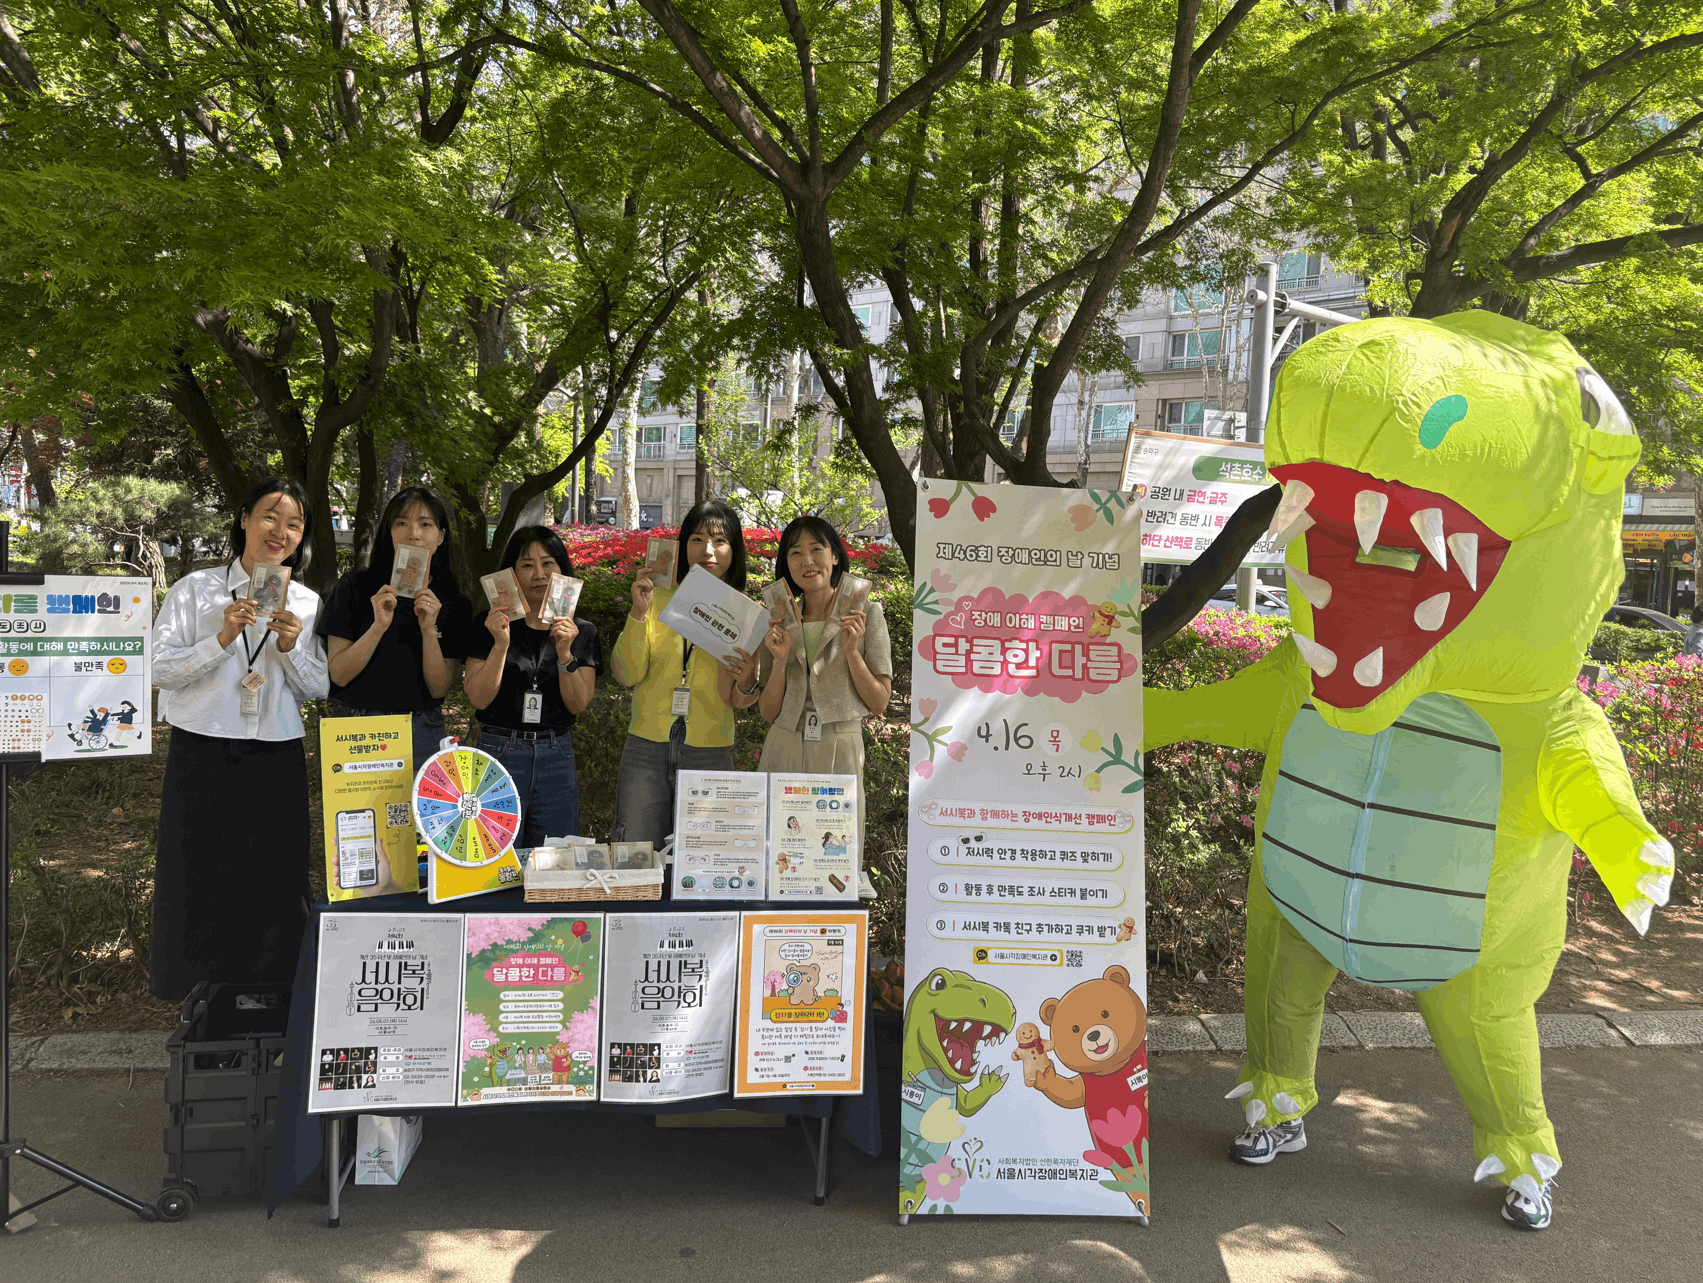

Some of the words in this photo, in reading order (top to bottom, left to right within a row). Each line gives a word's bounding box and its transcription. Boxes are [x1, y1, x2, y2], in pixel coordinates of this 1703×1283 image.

[1219, 462, 1263, 482] 석촌호수
[1150, 485, 1172, 501] 공원
[1174, 488, 1184, 502] 내
[1186, 489, 1228, 506] 금연·금주
[1145, 510, 1178, 526] 반려견
[1180, 512, 1200, 528] 동반
[1202, 514, 1212, 528] 시
[1141, 533, 1162, 548] 하단
[1164, 534, 1193, 550] 산책로
[936, 542, 992, 562] 제46회
[997, 546, 1062, 567] 장애인의
[1066, 551, 1084, 568] 날
[1088, 552, 1120, 570] 기념
[46, 592, 120, 614] 캠페인
[693, 606, 712, 622] 장애인
[710, 619, 724, 632] 관련
[723, 628, 738, 640] 문제
[971, 611, 1002, 628] 장애
[1006, 613, 1035, 630] 이해
[1040, 615, 1084, 632] 캠페인
[38, 642, 64, 652] 대해
[67, 641, 142, 653] 만족하시나요?
[74, 661, 104, 672] 불만족
[933, 635, 1042, 678] 달콤한
[1051, 640, 1122, 683] 다름
[336, 734, 366, 742] 서시복과
[368, 732, 399, 742] 카친하고
[976, 718, 1034, 751] 4.16
[1048, 730, 1062, 752] 목
[348, 744, 380, 754] 선물받자
[1022, 760, 1052, 782] 오후
[1058, 764, 1082, 778] 2시
[939, 807, 976, 820] 서시복과
[979, 808, 1018, 822] 함께하는
[1022, 810, 1082, 825] 장애인식개선
[1085, 813, 1117, 827] 캠페인
[966, 846, 994, 860] 저시력
[996, 848, 1017, 862] 안경
[1020, 848, 1056, 862] 착용하고
[1059, 850, 1078, 862] 퀴즈
[1080, 852, 1112, 864] 맞히기!
[964, 883, 982, 896] 활동
[986, 884, 994, 897] 후
[997, 884, 1024, 898] 만족도
[1028, 886, 1046, 898] 조사
[1049, 886, 1076, 898] 스티커
[1079, 888, 1108, 900] 붙이기
[962, 920, 990, 934] 서시복
[992, 922, 1012, 935] 카톡
[1014, 922, 1033, 935] 친구
[1036, 923, 1072, 936] 추가하고
[1076, 924, 1094, 936] 쿠키
[1096, 925, 1117, 938] 받기
[994, 952, 1048, 962] 서울시각장애인복지관
[493, 967, 535, 982] 달콤한
[538, 967, 566, 981] 다름
[356, 986, 424, 1012] 음악회
[639, 984, 703, 1010] 음악회
[998, 1158, 1037, 1166] 사회복지법인
[1039, 1158, 1080, 1166] 선한목자재단
[996, 1168, 1099, 1181] 서울시각장애인복지관
